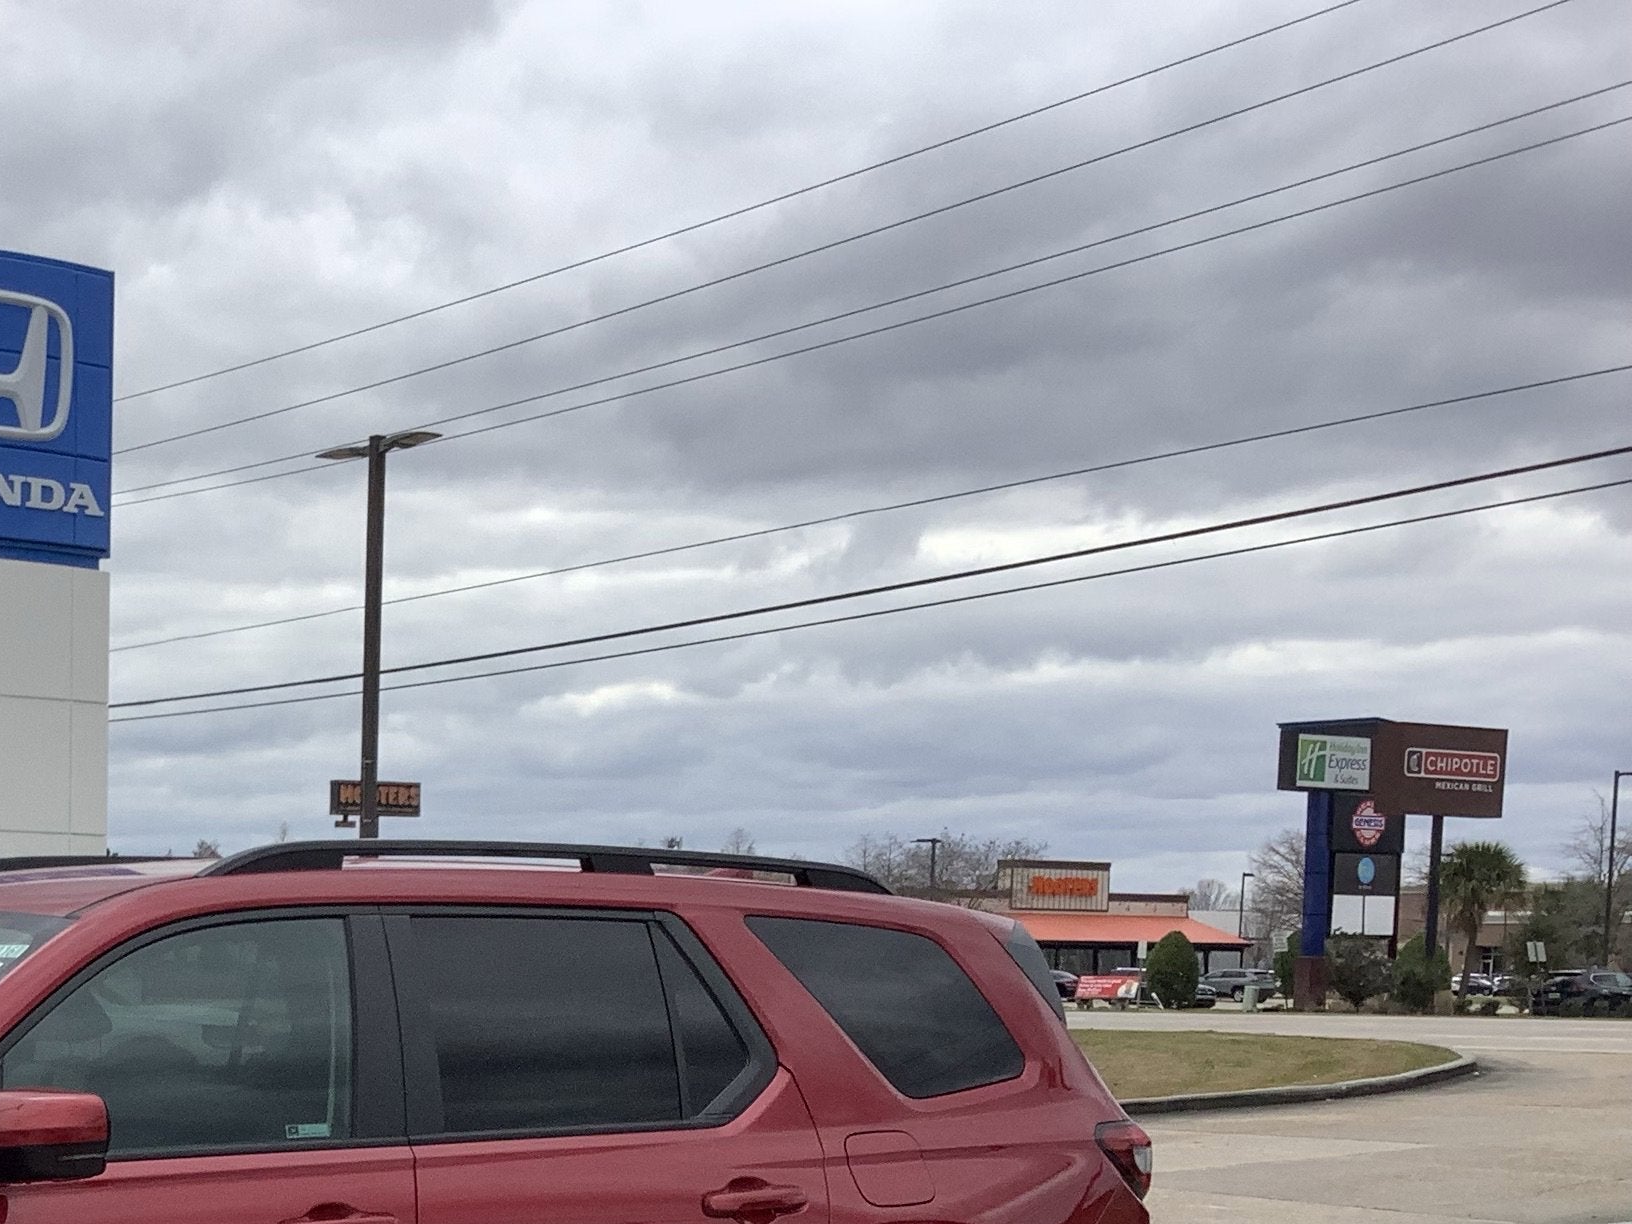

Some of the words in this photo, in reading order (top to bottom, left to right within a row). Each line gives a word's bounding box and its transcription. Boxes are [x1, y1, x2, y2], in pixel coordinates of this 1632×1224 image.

[1328, 753, 1368, 773] Express
[1426, 756, 1496, 775] CHIPOTLE
[1435, 781, 1469, 791] MEXICAN
